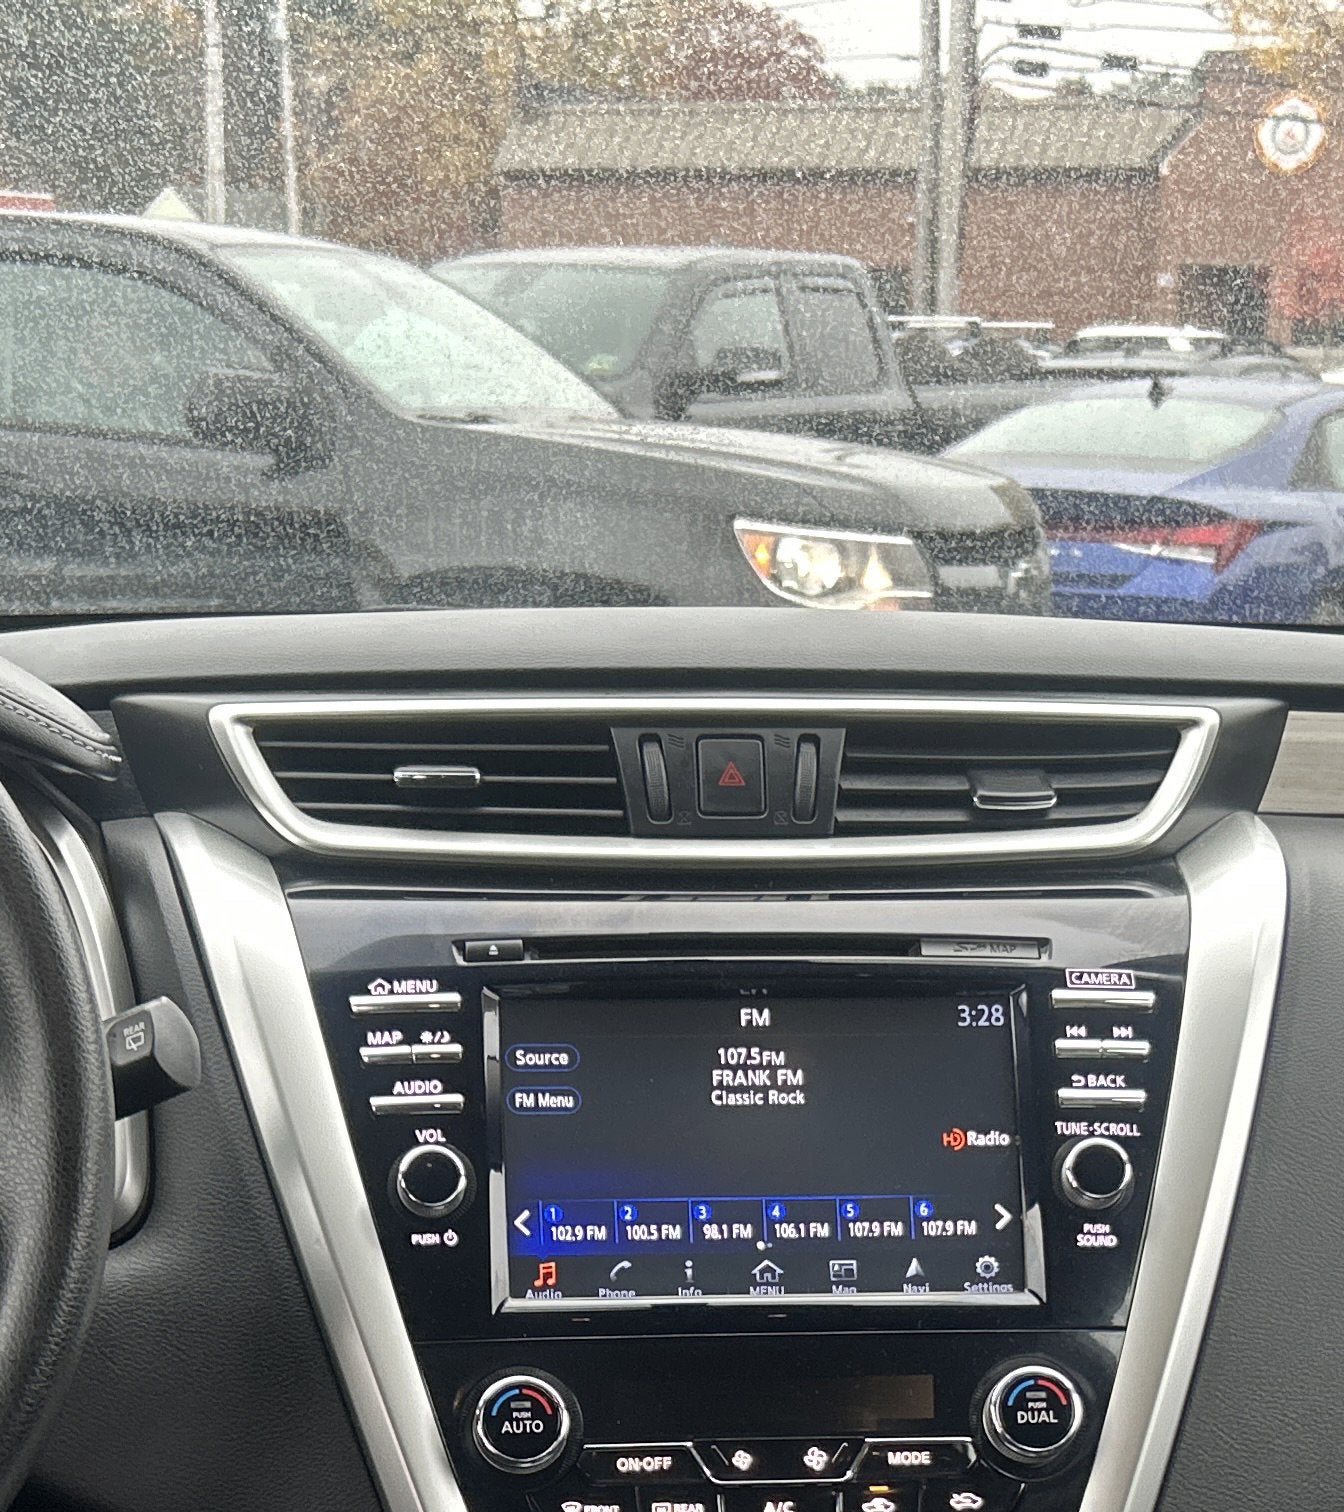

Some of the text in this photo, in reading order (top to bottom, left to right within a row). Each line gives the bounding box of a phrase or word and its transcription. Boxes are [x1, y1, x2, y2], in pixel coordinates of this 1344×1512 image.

[1071, 972, 1131, 986] CAMERA
[393, 979, 438, 994] MENU
[740, 1008, 770, 1027] FM
[957, 1004, 1005, 1027] 3:28
[123, 1021, 145, 1037] REAR
[367, 1031, 403, 1045] MAP
[515, 1049, 569, 1066] Source
[712, 1069, 803, 1086] FRANK FM
[1087, 1075, 1125, 1088] BACK
[392, 1080, 442, 1095] AUDIO
[514, 1092, 574, 1109] FM Menu
[711, 1089, 805, 1106] Classic Rock
[415, 1128, 447, 1143] VOL
[966, 1131, 1011, 1146] Radio
[624, 1206, 633, 1220] 2
[698, 1206, 708, 1219] 3
[771, 1206, 781, 1219] 4
[845, 1205, 855, 1218] 5
[919, 1203, 929, 1217] 6
[550, 1226, 607, 1242] 102.9 FM
[625, 1225, 682, 1241] 100.5 FM
[702, 1224, 753, 1239] 98.1 FM
[774, 1223, 830, 1238] 106.1 FM
[848, 1222, 903, 1237] 107.9 FM
[921, 1220, 977, 1237] 107.9 FM
[1083, 1223, 1110, 1235] PUSH
[411, 1233, 440, 1246] PUSH
[1076, 1234, 1118, 1248] SOUND
[525, 1288, 562, 1299] Audio
[598, 1287, 636, 1298] Phone
[678, 1286, 702, 1297] Info
[749, 1286, 785, 1295] MENU
[903, 1283, 930, 1293] Navi
[964, 1281, 1014, 1293] Settings
[1027, 1401, 1047, 1409] PUSH
[1017, 1410, 1058, 1424] DUAL
[501, 1420, 544, 1434] AUTO
[887, 1451, 931, 1465] MODE
